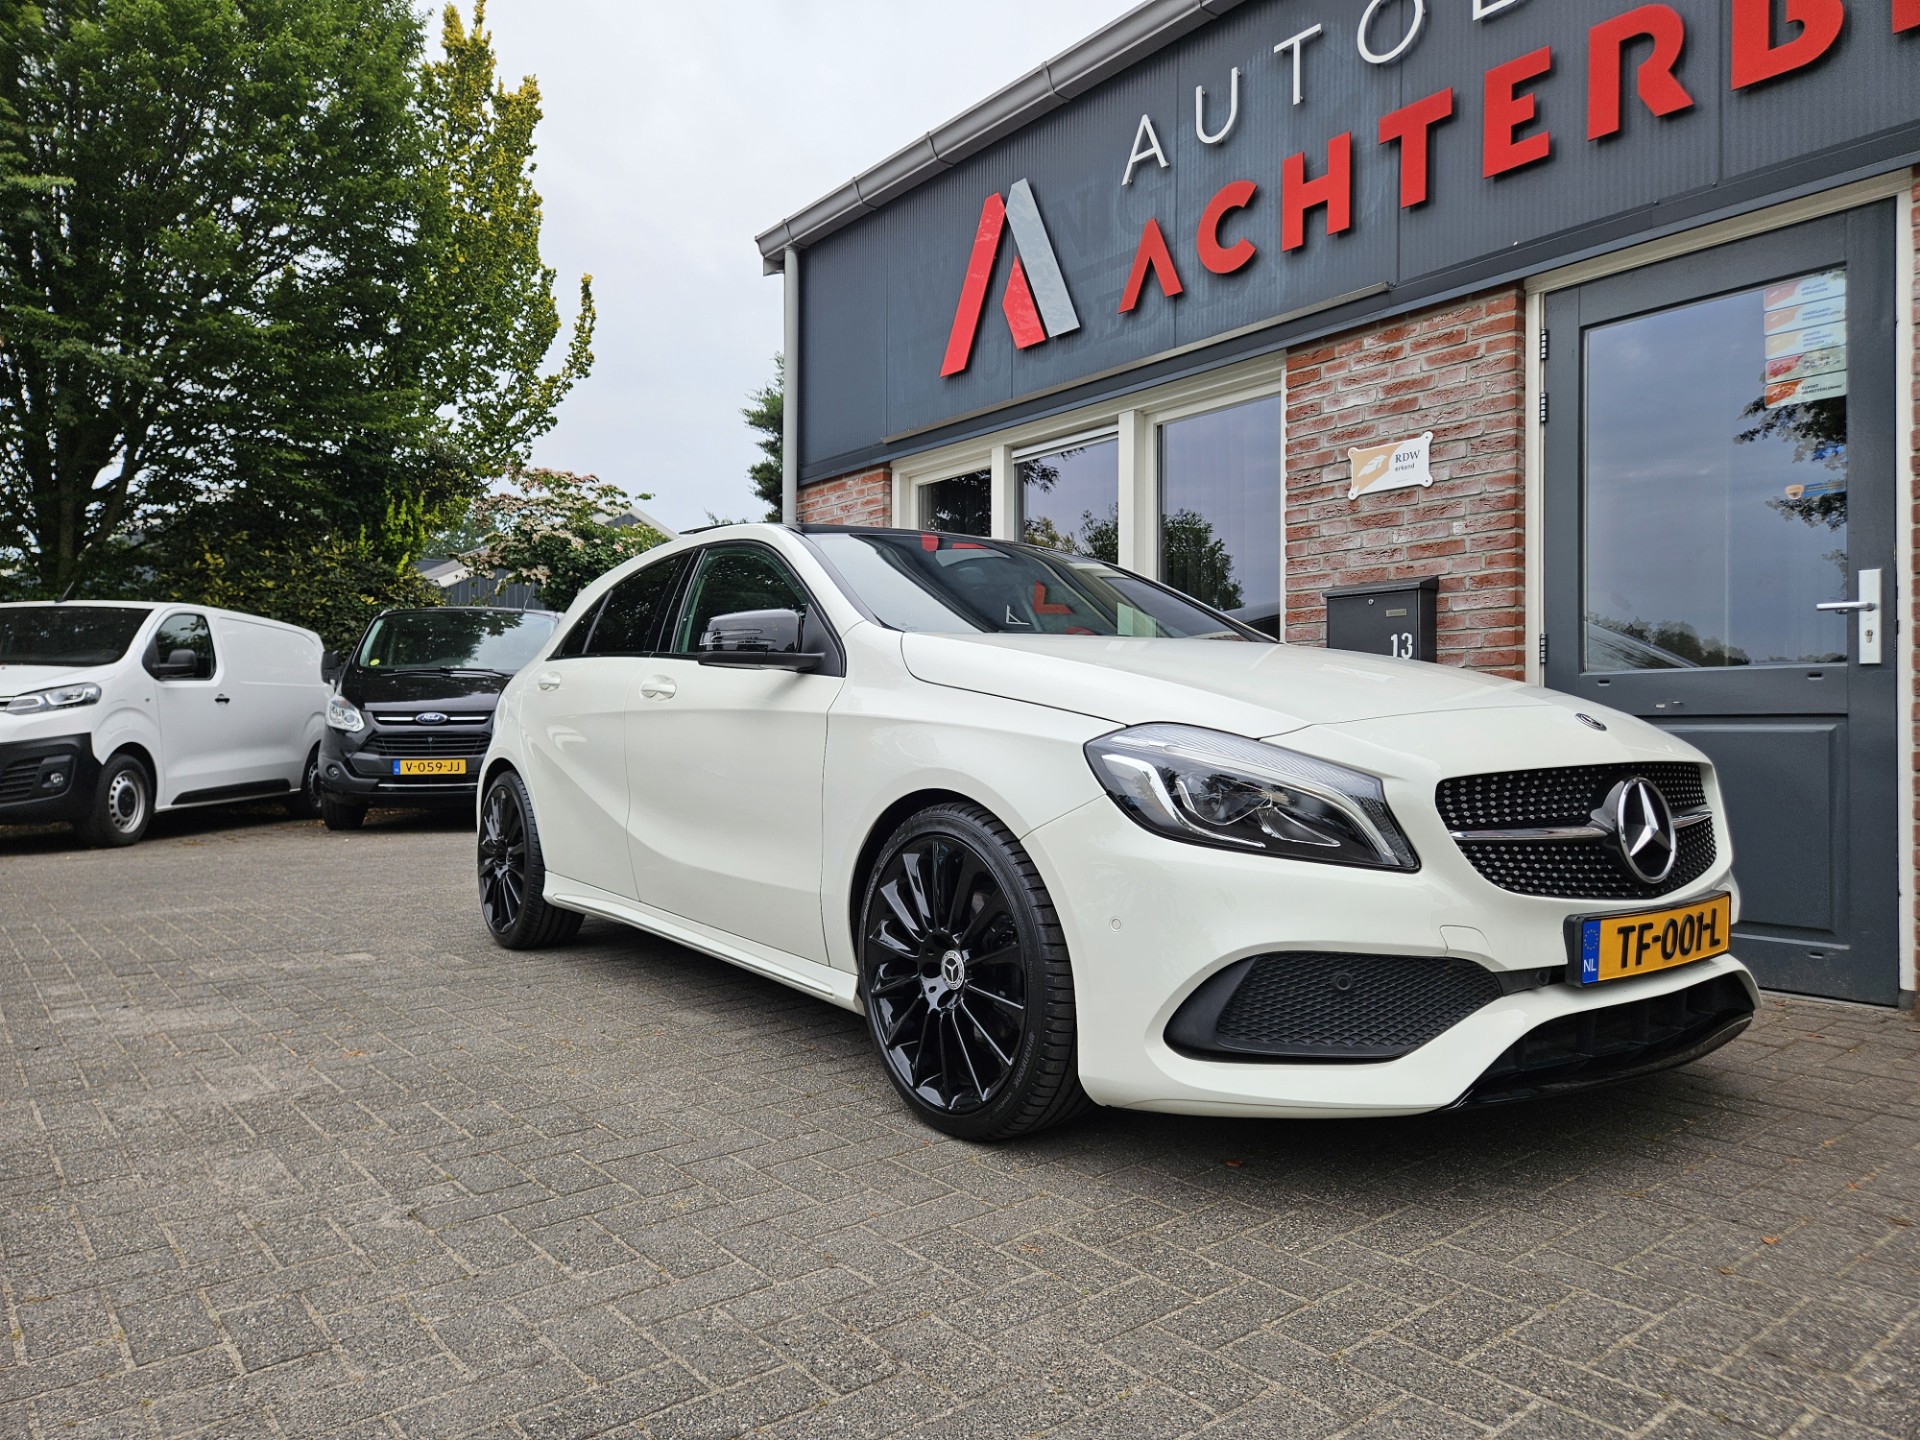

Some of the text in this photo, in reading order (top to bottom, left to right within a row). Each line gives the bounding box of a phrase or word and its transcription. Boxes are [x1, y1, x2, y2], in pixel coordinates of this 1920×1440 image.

[1121, 0, 1519, 186] AUTO
[1118, 0, 1920, 314] ACHTERB
[1395, 449, 1421, 463] RDW
[1395, 463, 1415, 472] erkend
[1391, 632, 1413, 660] 13
[405, 761, 461, 772] V-059-JJ
[1583, 907, 1721, 973] NL TF-001-L
